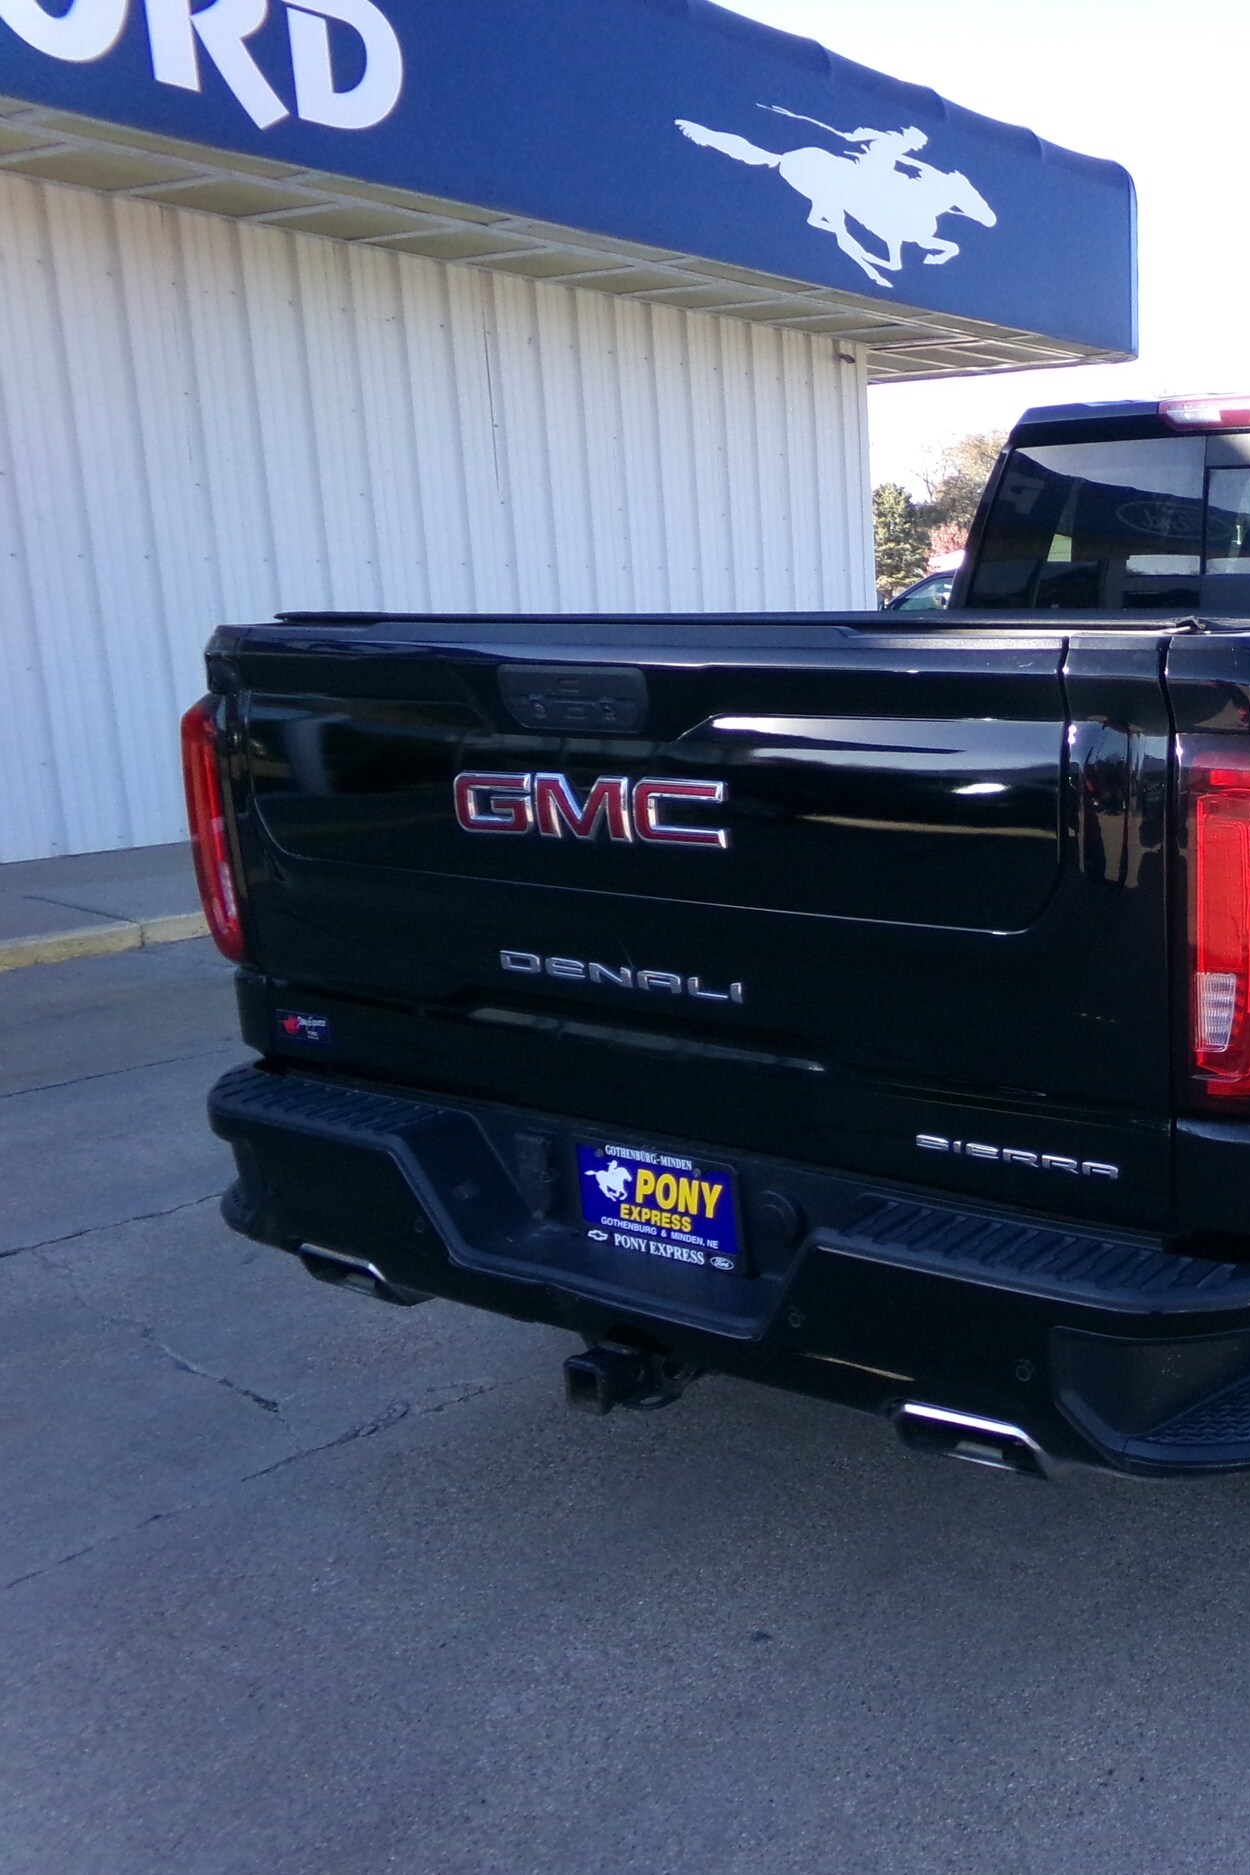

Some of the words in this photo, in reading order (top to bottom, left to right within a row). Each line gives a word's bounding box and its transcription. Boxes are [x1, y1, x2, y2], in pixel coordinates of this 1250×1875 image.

[453, 770, 729, 849] GMC
[500, 950, 743, 1004] DENALI
[605, 1144, 692, 1171] GOTHENBURG-MINDEN
[916, 1134, 1119, 1179] SIERRA
[635, 1168, 723, 1219] PONY
[600, 1216, 658, 1236] GOTHENBURG
[660, 1229, 667, 1238] &
[670, 1231, 705, 1247] MINDEN,
[706, 1239, 719, 1249] NE
[620, 1203, 692, 1233] EXPRESS
[613, 1233, 648, 1253] PONY
[649, 1241, 705, 1266] EXPRESS
